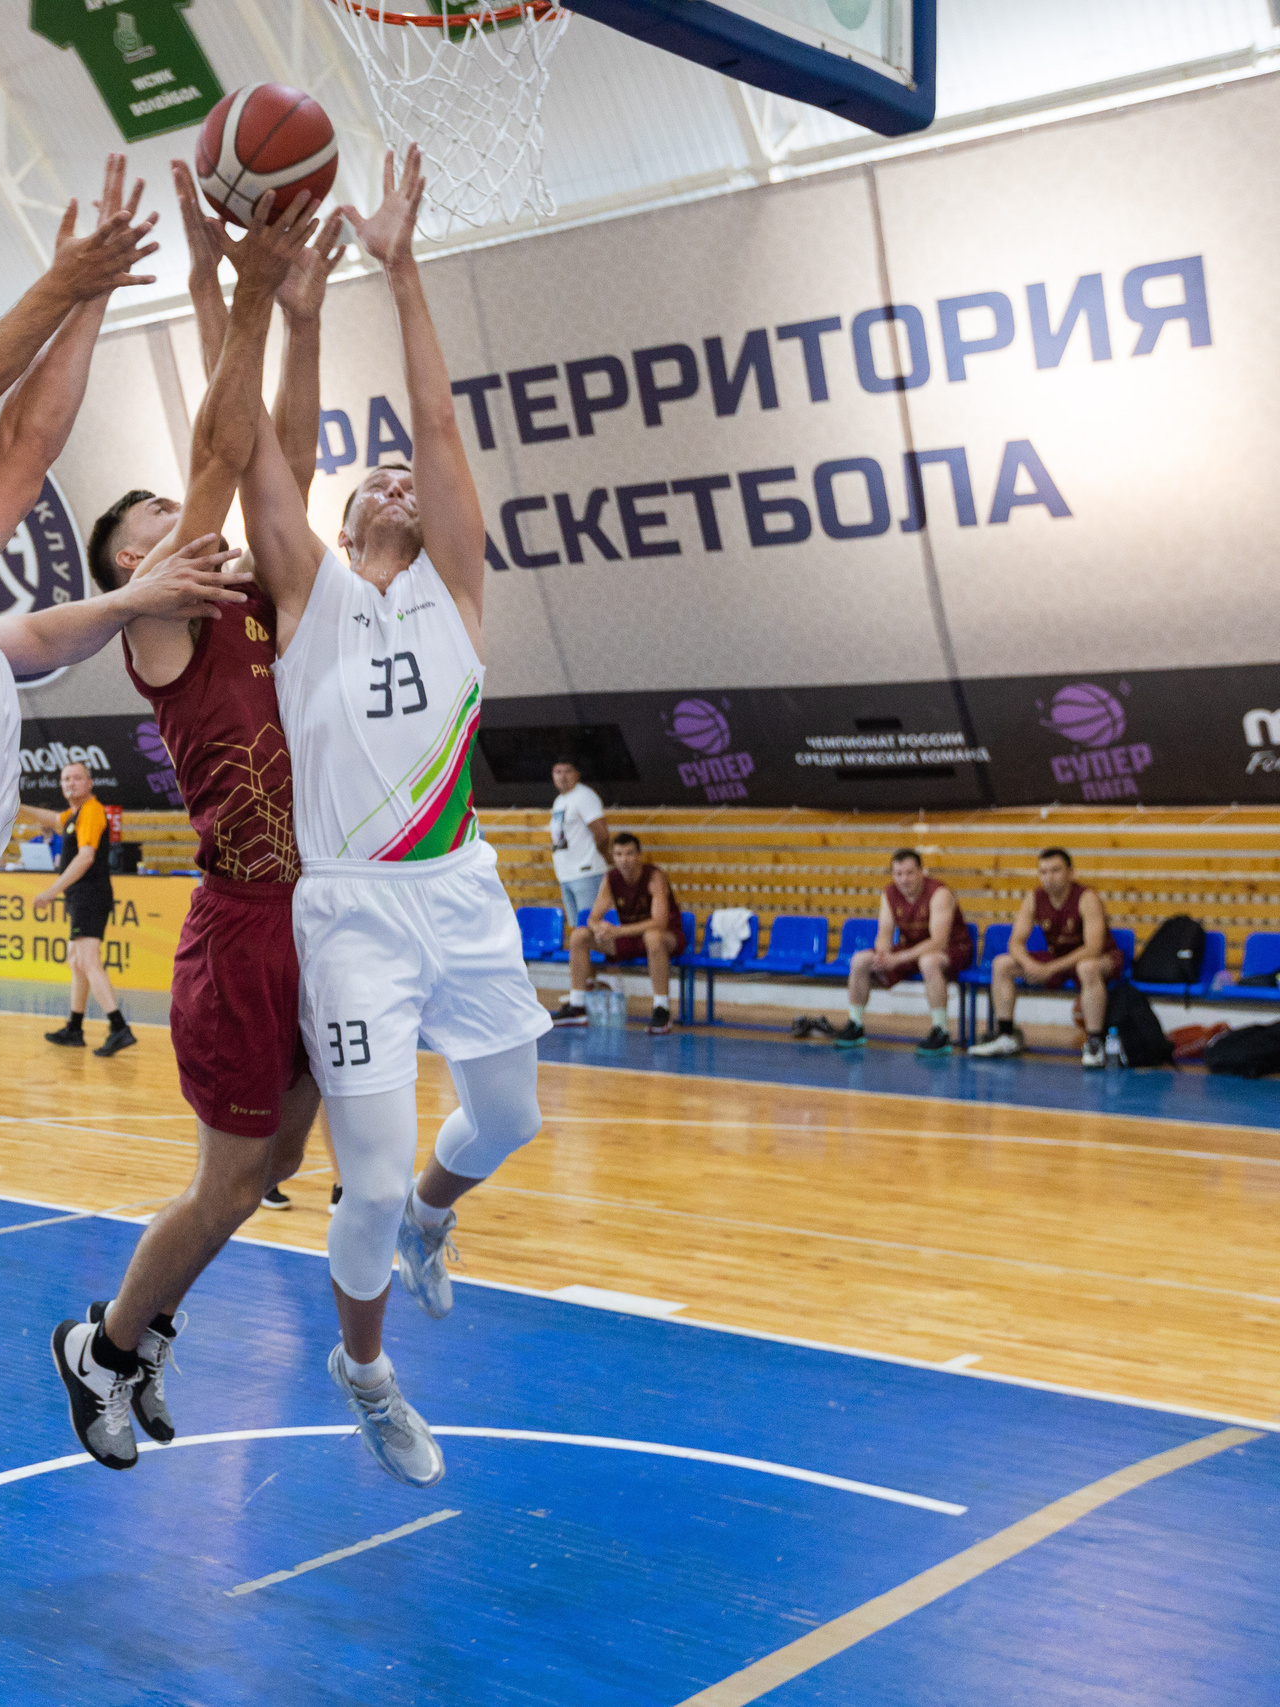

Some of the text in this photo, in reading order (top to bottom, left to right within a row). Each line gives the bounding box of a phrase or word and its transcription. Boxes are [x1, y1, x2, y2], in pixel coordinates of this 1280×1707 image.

[316, 254, 1214, 474] ФА ТЕРРИТОРИЯ
[485, 438, 1074, 572] СКЕТБОЛА
[366, 651, 427, 718] 33
[795, 746, 991, 767] СРЕДИ МУЖСКИХ КОМАНД
[805, 731, 966, 750] ЧЕМПИОНАТ РОССИИ
[678, 751, 755, 788] СУПЕР
[1050, 742, 1153, 784] СУПЕР
[1081, 776, 1138, 801] ЛИГА
[33, 897, 139, 927] СПТА
[33, 937, 130, 973] ПОД!
[327, 1020, 371, 1067] 33
